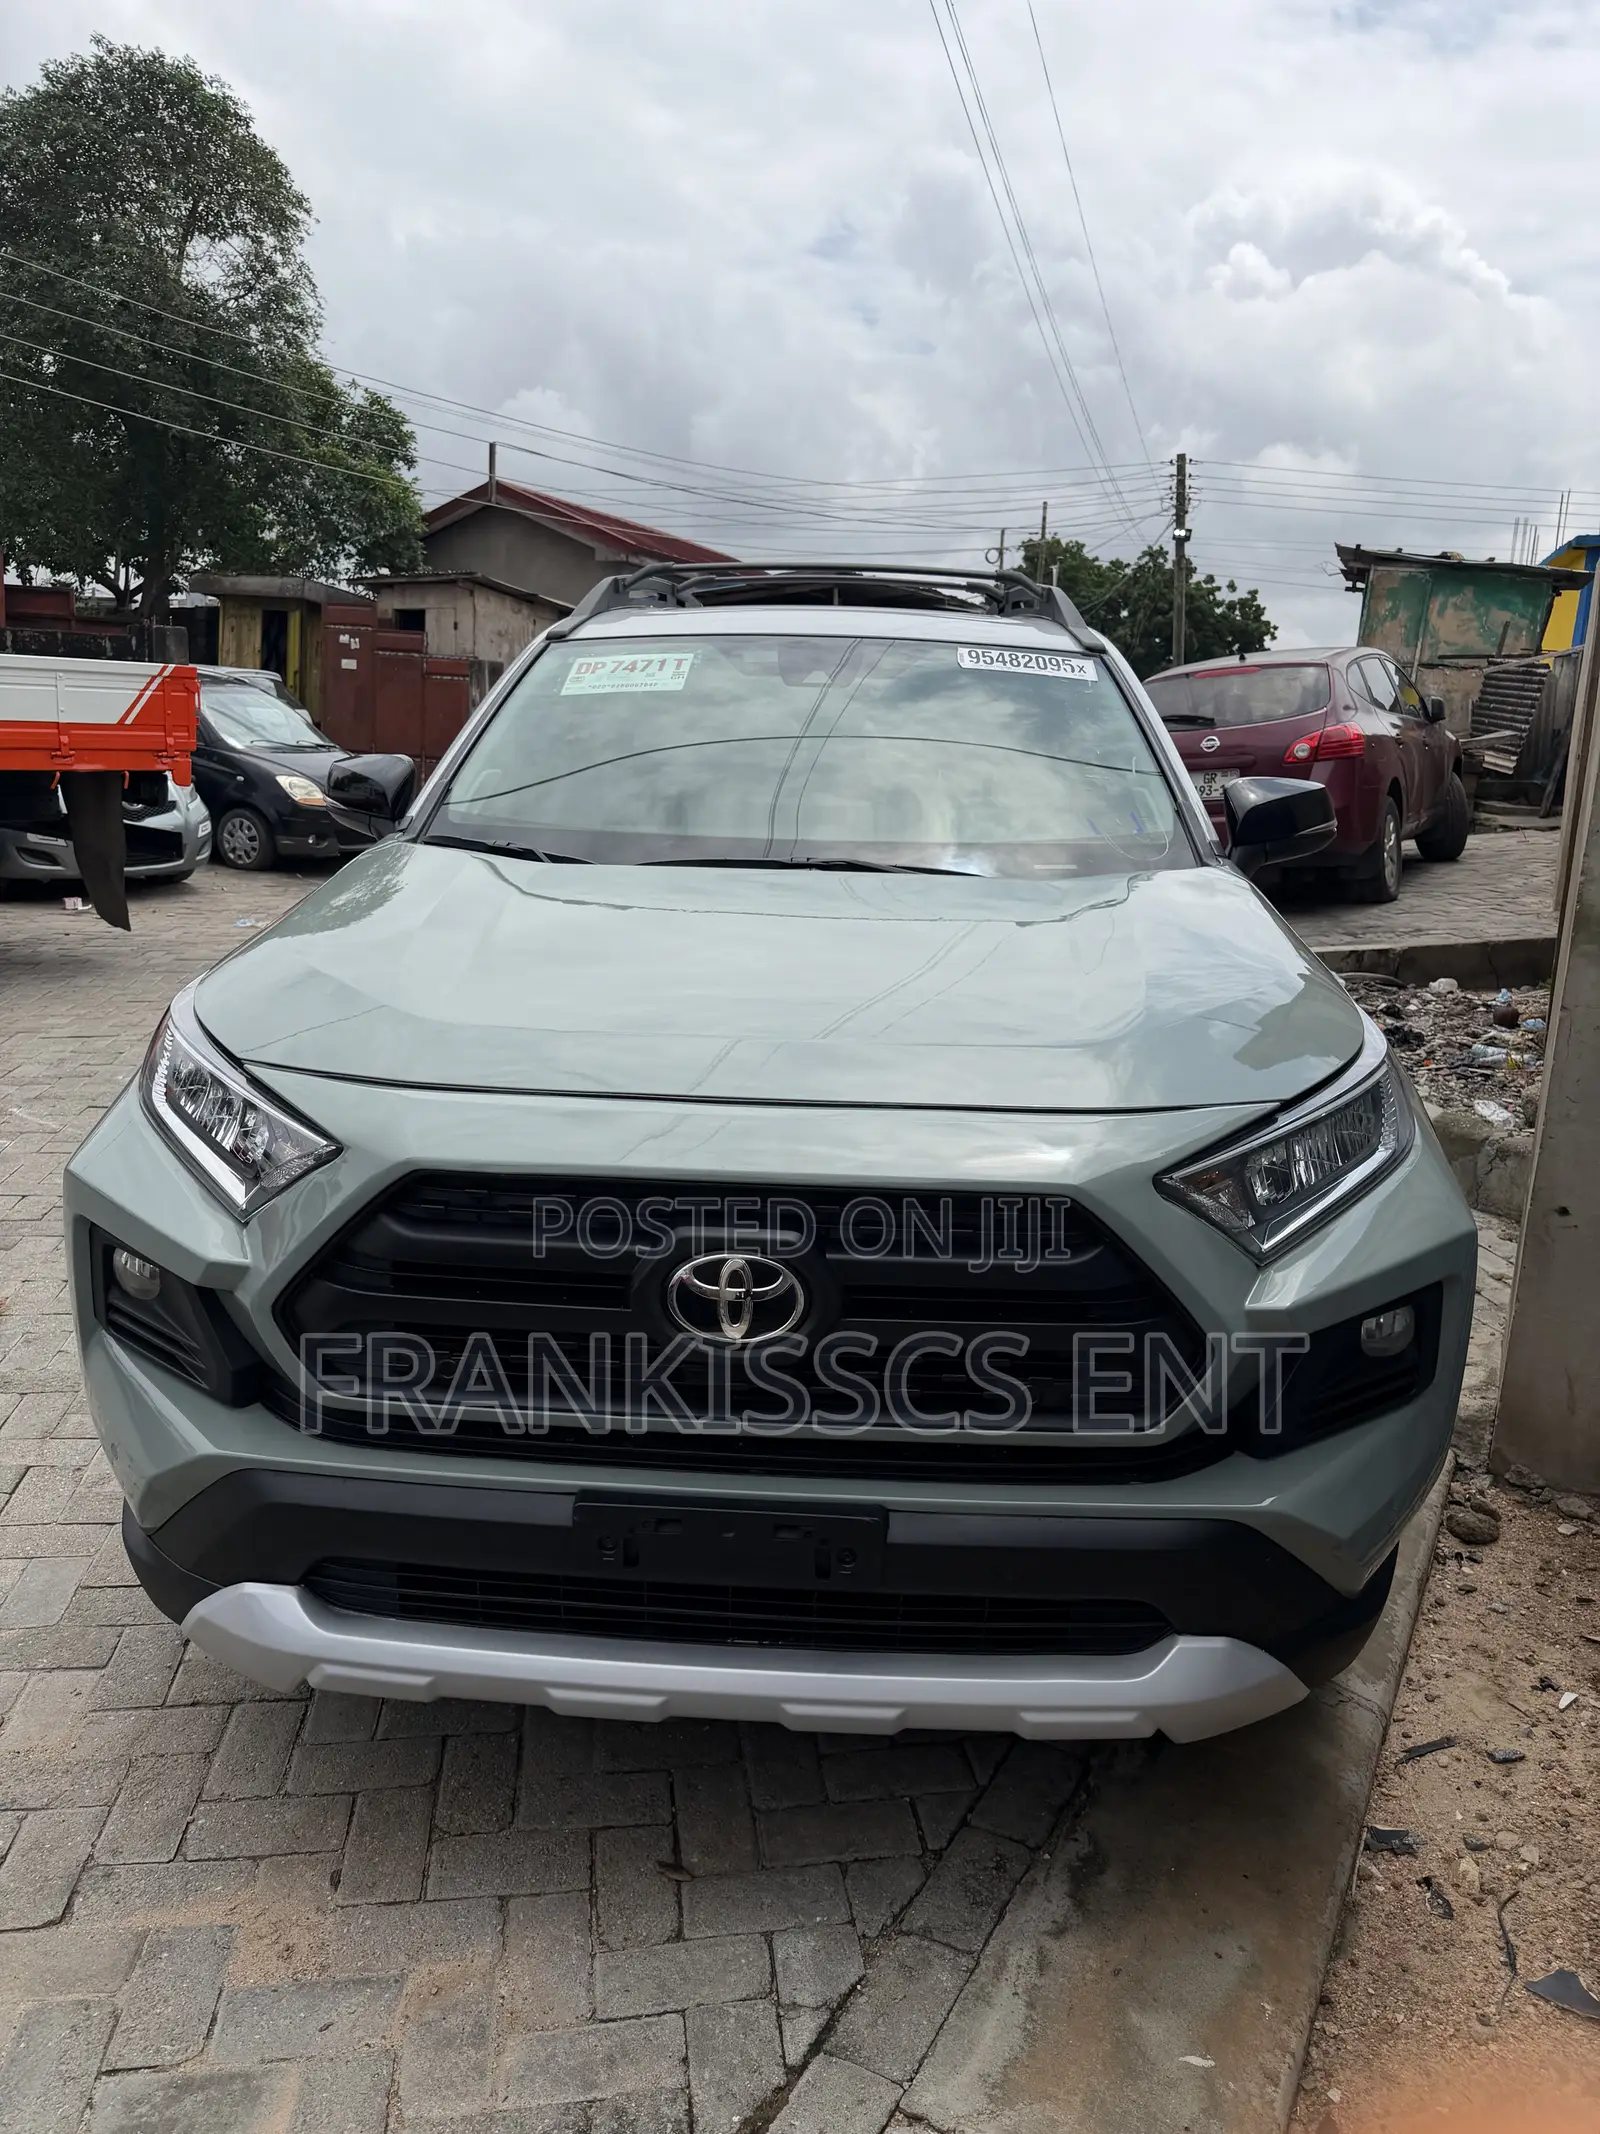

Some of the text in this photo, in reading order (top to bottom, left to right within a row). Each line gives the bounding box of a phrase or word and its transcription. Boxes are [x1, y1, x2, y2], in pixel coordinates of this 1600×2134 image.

[575, 659, 688, 675] DP 7471 T
[1203, 772, 1217, 784] GR
